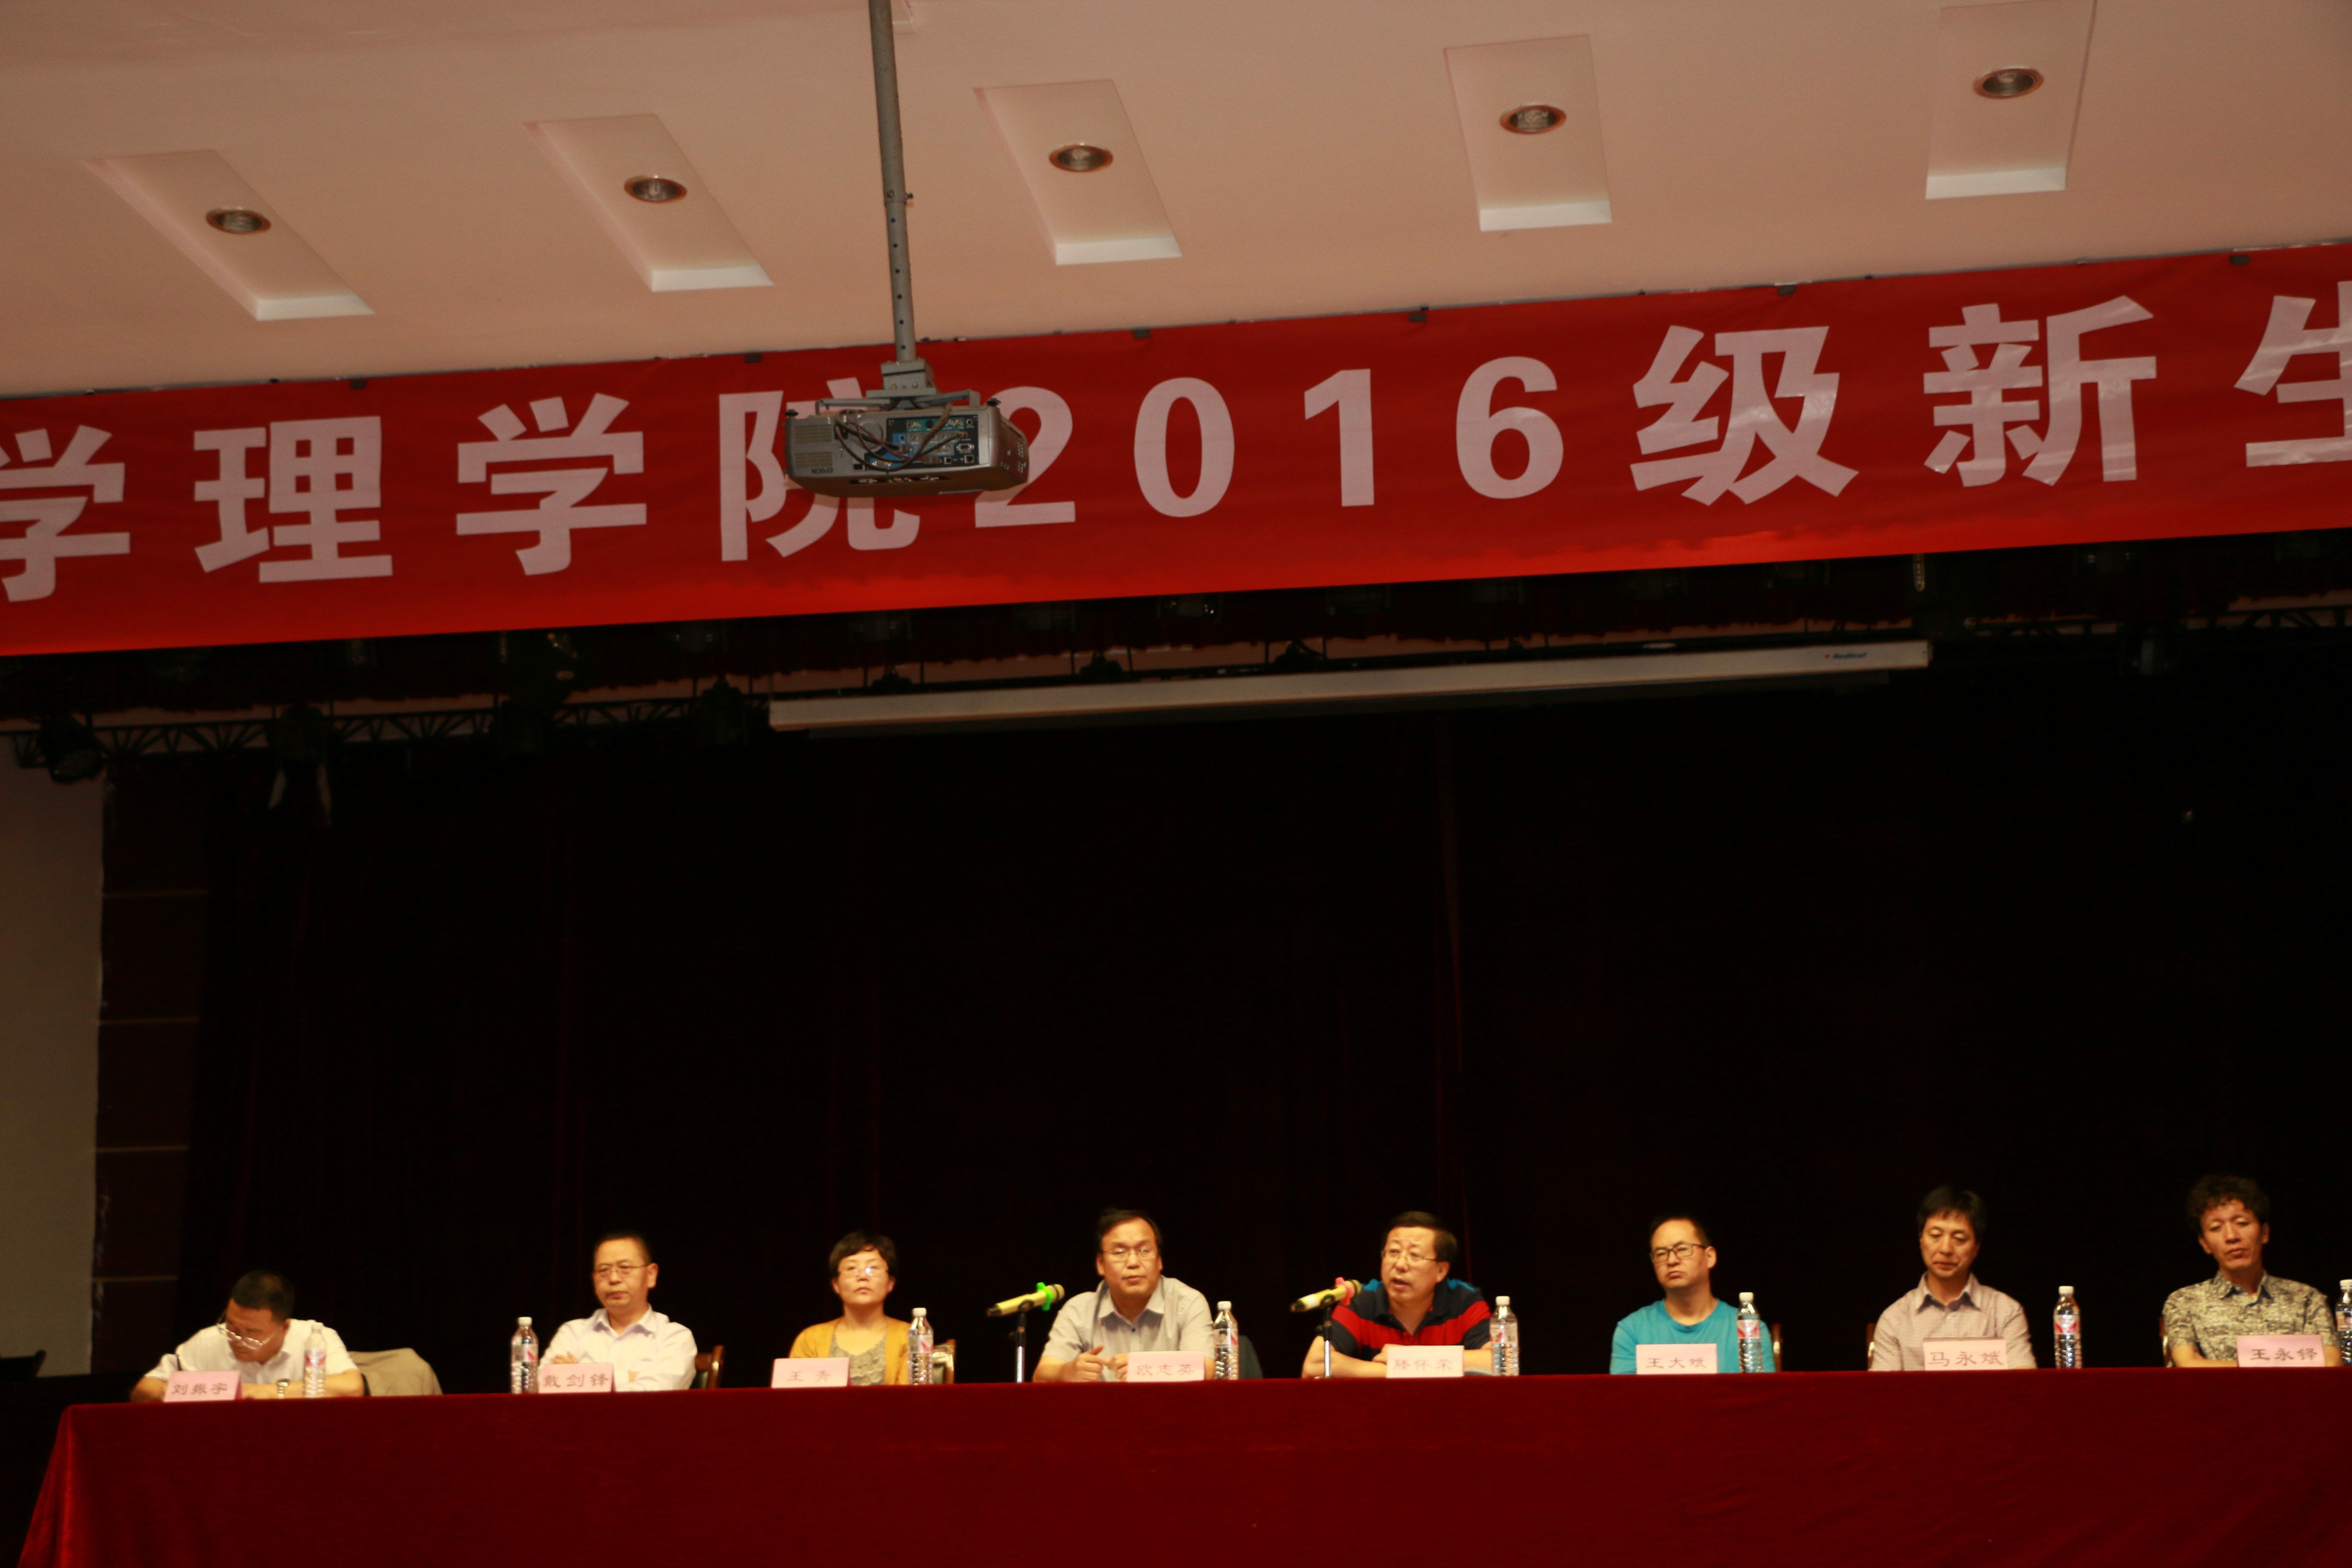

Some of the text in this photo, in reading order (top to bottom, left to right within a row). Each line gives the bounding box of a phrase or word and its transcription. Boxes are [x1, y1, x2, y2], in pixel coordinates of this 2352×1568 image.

[1645, 1357, 1707, 1369] 王大斌
[1928, 1351, 2004, 1367] 马永斌
[1136, 1363, 1194, 1376] 欧志英
